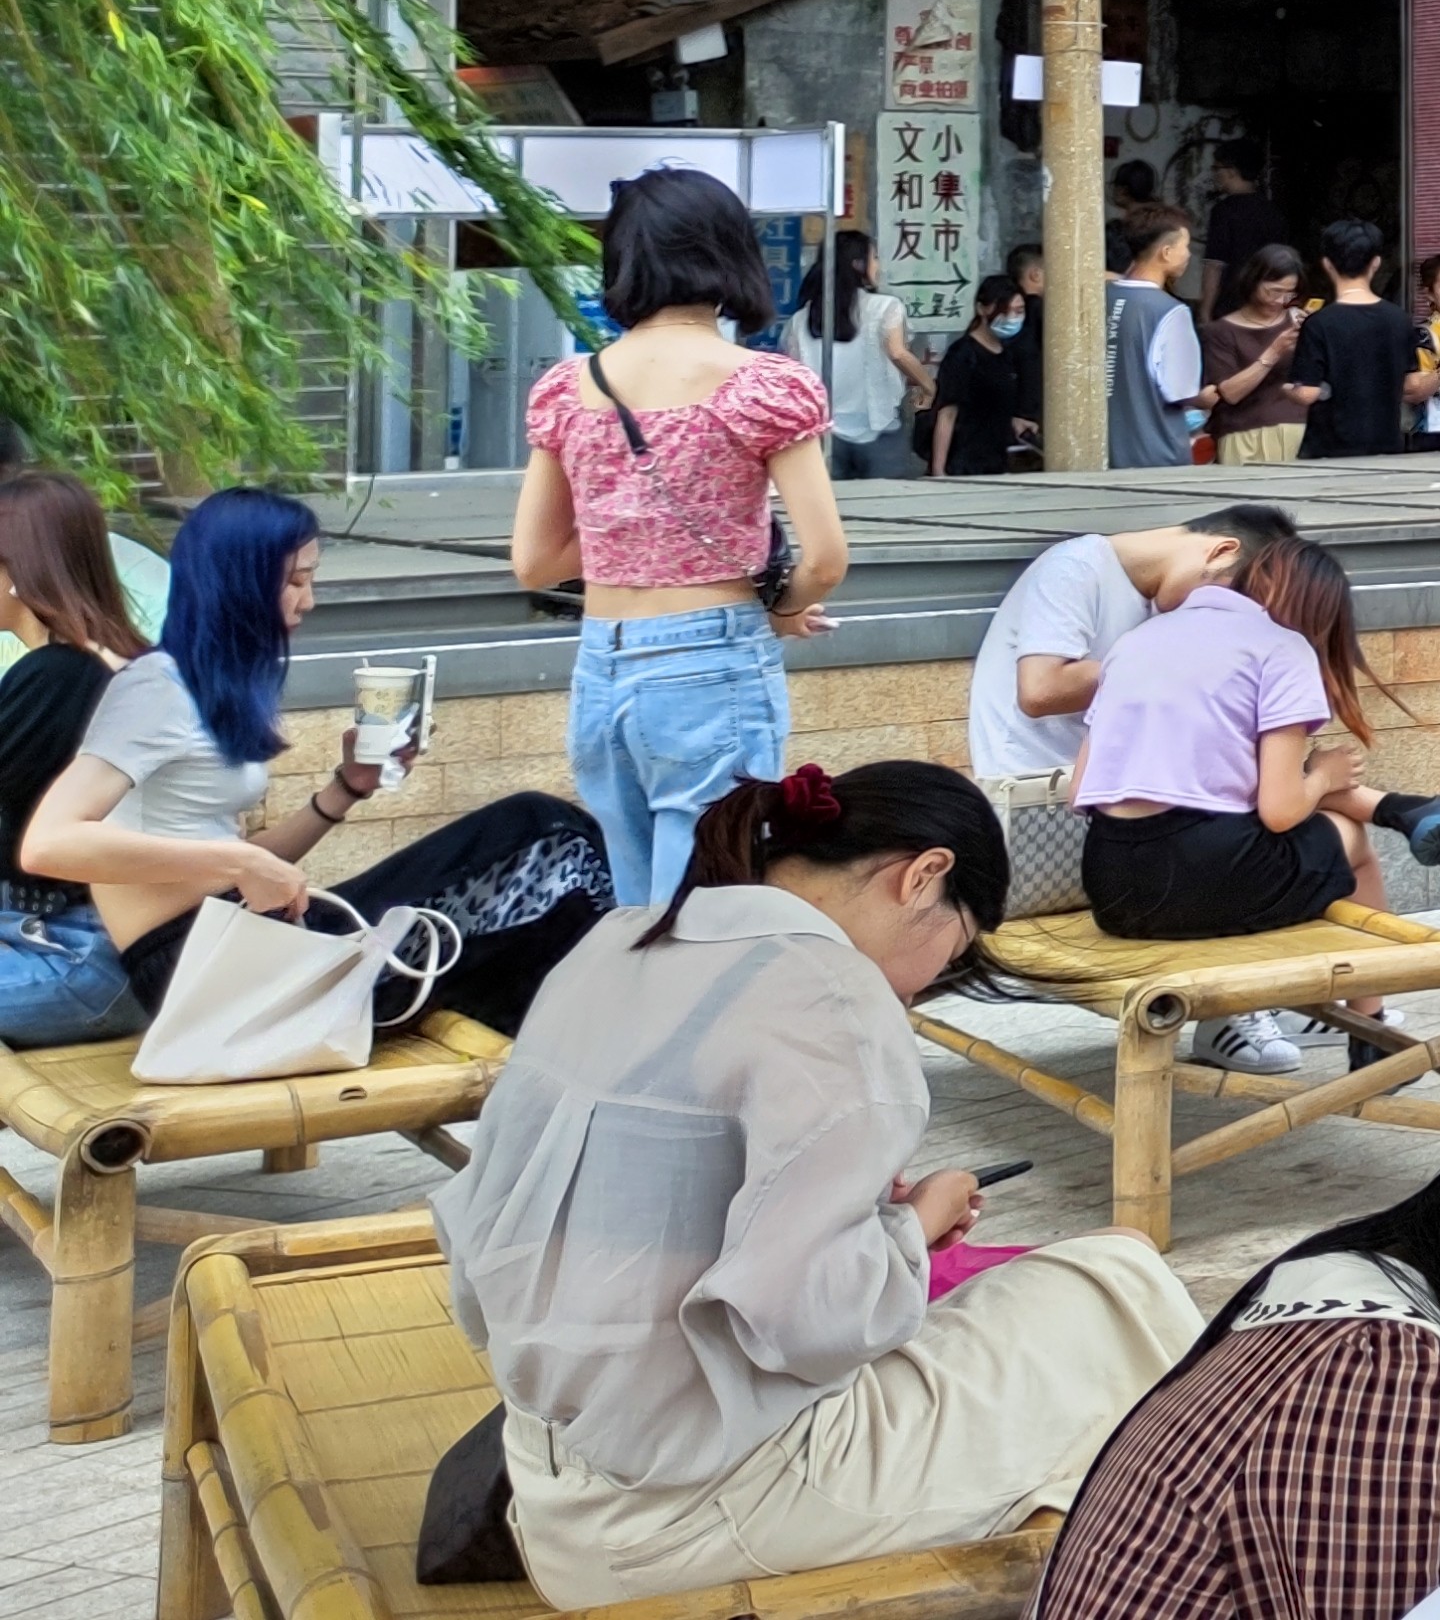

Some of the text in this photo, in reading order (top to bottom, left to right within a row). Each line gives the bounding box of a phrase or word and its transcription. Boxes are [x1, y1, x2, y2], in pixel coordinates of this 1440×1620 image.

[890, 121, 926, 261] 文和友
[930, 124, 965, 263] 小集市
